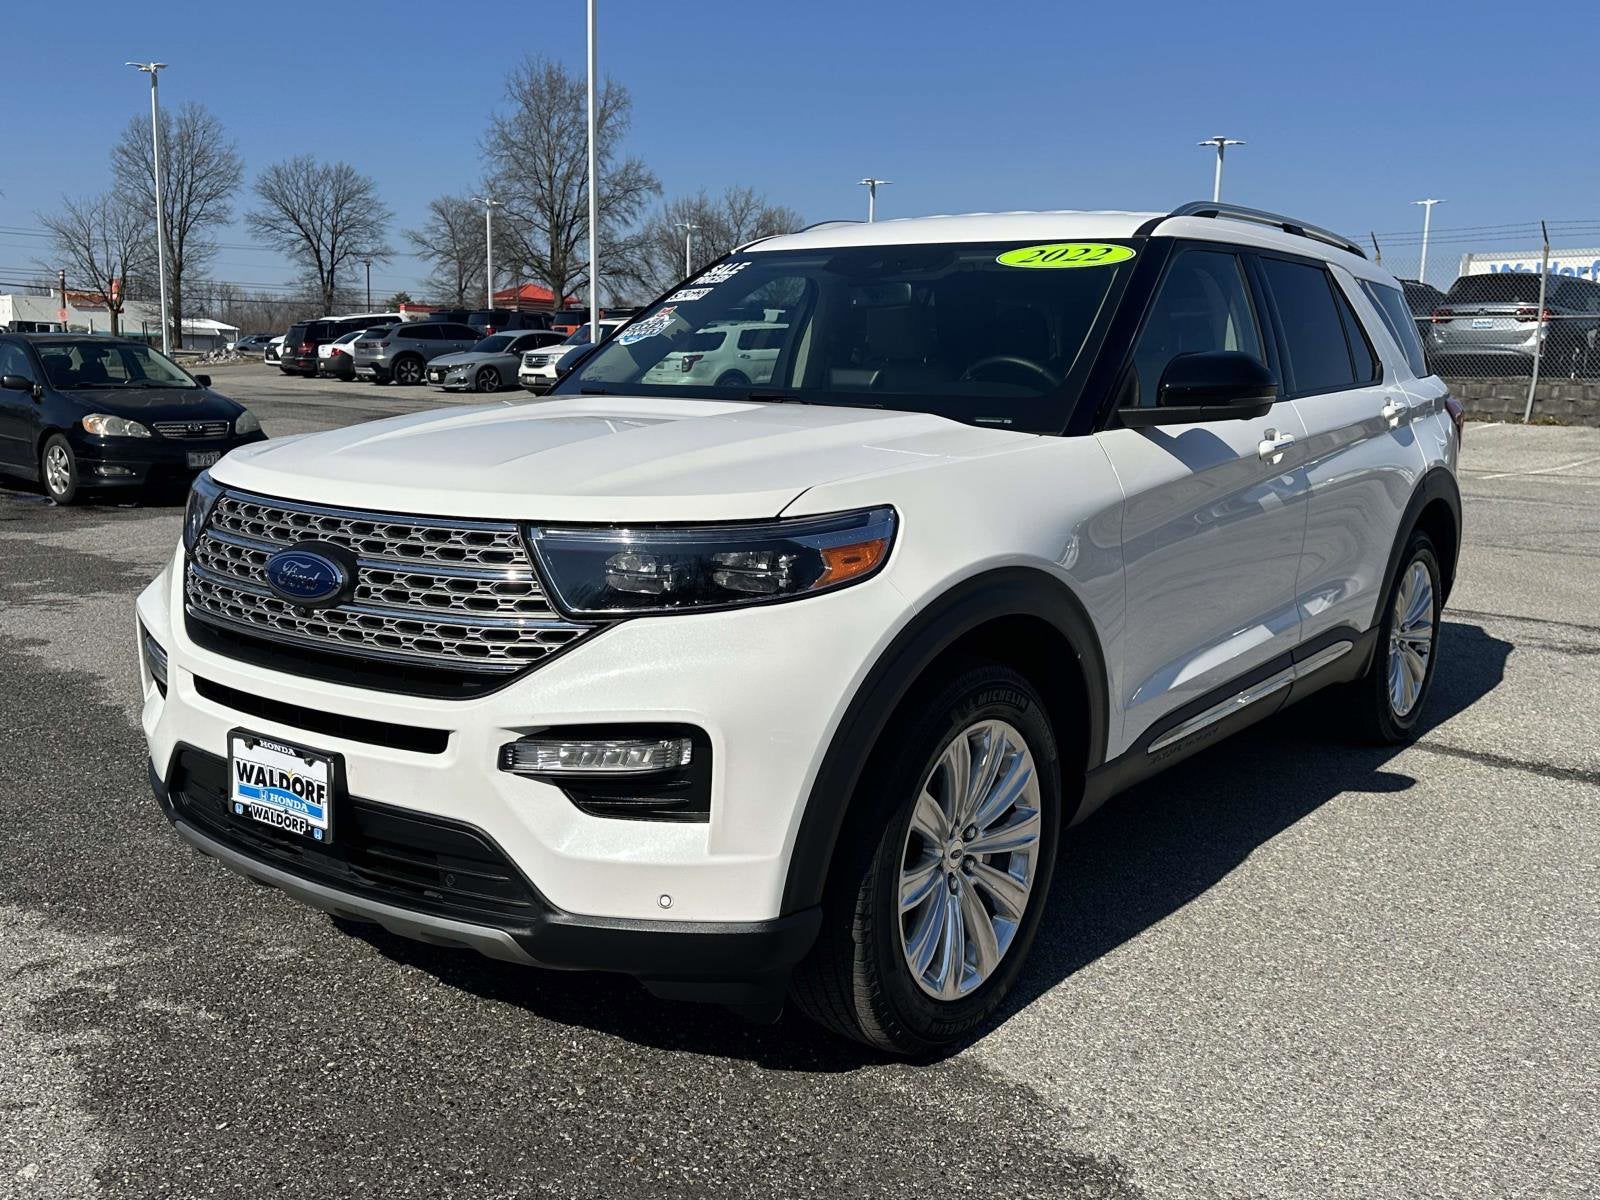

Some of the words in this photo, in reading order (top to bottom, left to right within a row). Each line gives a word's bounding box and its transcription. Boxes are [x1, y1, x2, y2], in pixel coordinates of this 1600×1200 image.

[1017, 247, 1113, 263] 2022
[279, 560, 321, 590] Ford
[977, 688, 1029, 711] MICHELIN
[259, 740, 296, 756] HONDA
[236, 760, 326, 805] WALDORF
[269, 793, 309, 813] HONDA
[251, 805, 306, 834] WALDORF
